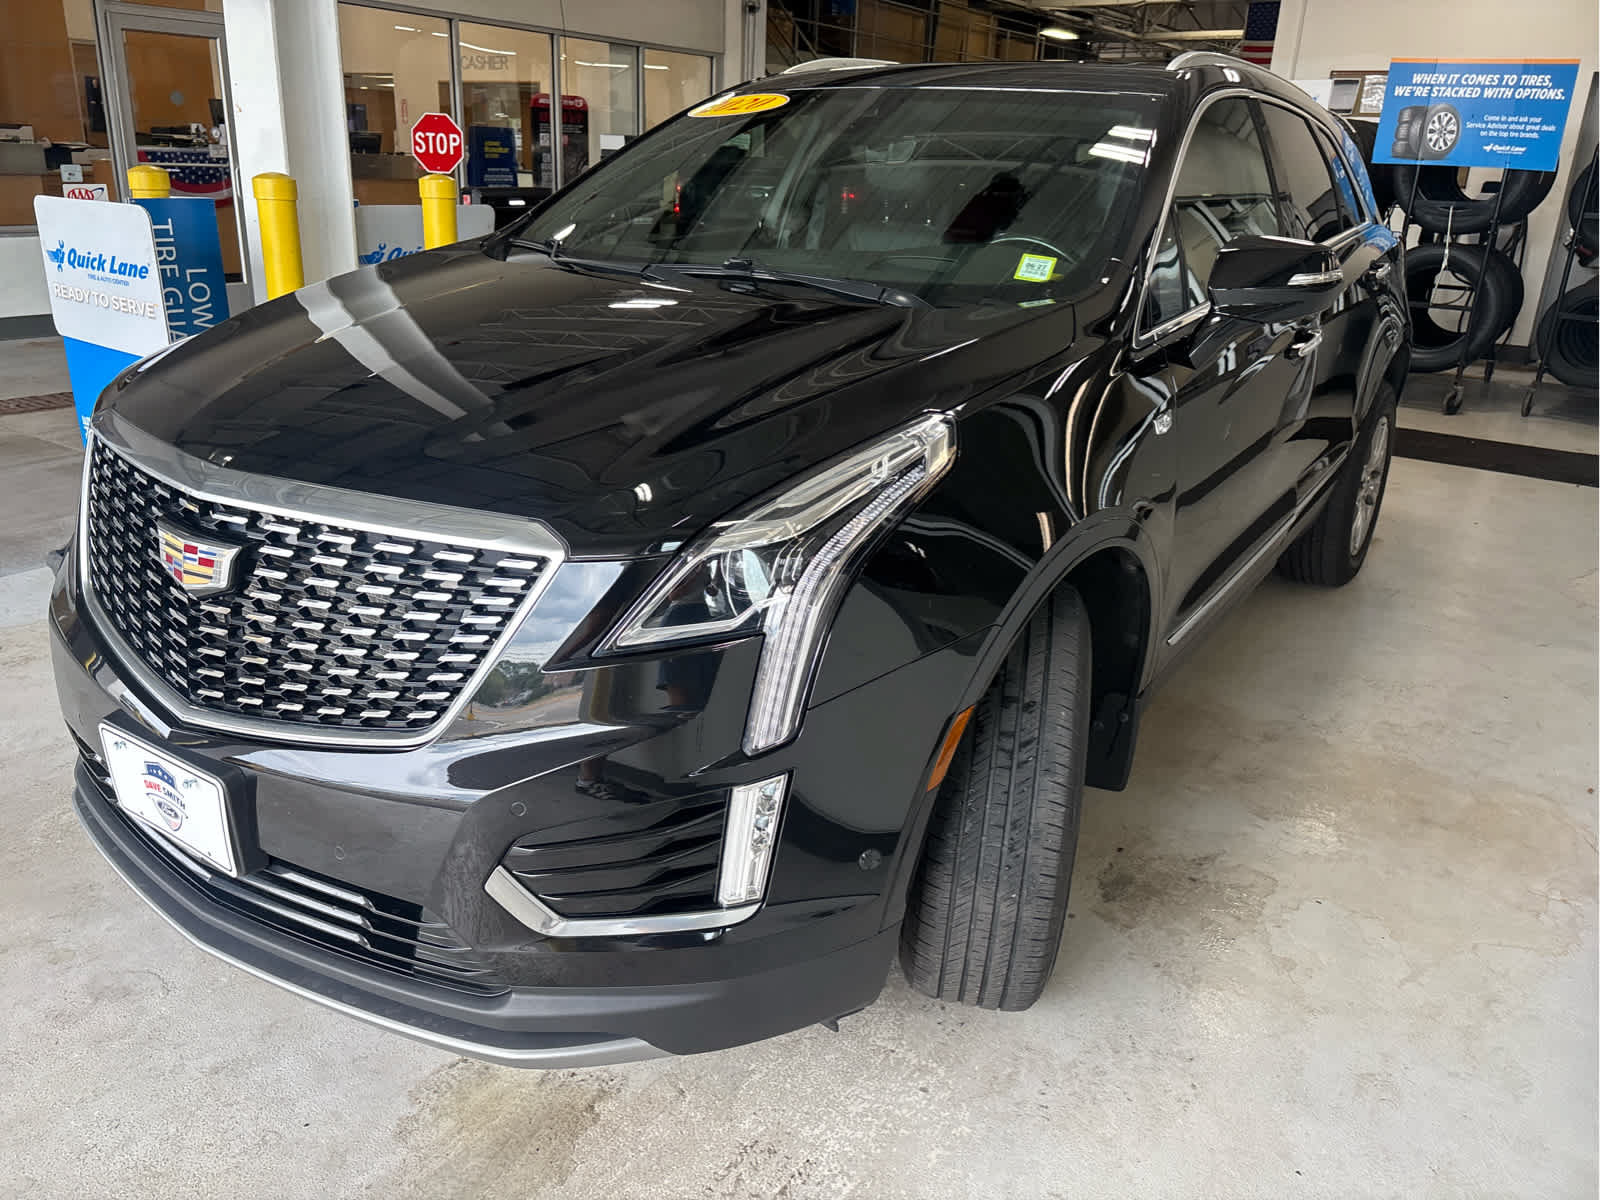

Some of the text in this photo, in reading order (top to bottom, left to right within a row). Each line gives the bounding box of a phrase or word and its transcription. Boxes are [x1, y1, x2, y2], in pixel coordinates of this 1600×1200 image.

[461, 55, 509, 71] CASHIER
[1412, 73, 1553, 88] WHEN IT COMES TO TIRES,
[1394, 86, 1566, 100] WE'RE STACKED WITH OPTIONS.
[415, 131, 460, 155] STOP
[152, 218, 179, 278] TIRE
[67, 247, 149, 280] Quick Lane
[54, 283, 158, 320] READY TO SERVE
[185, 267, 215, 328] LOW
[163, 786, 186, 810] SMITH
